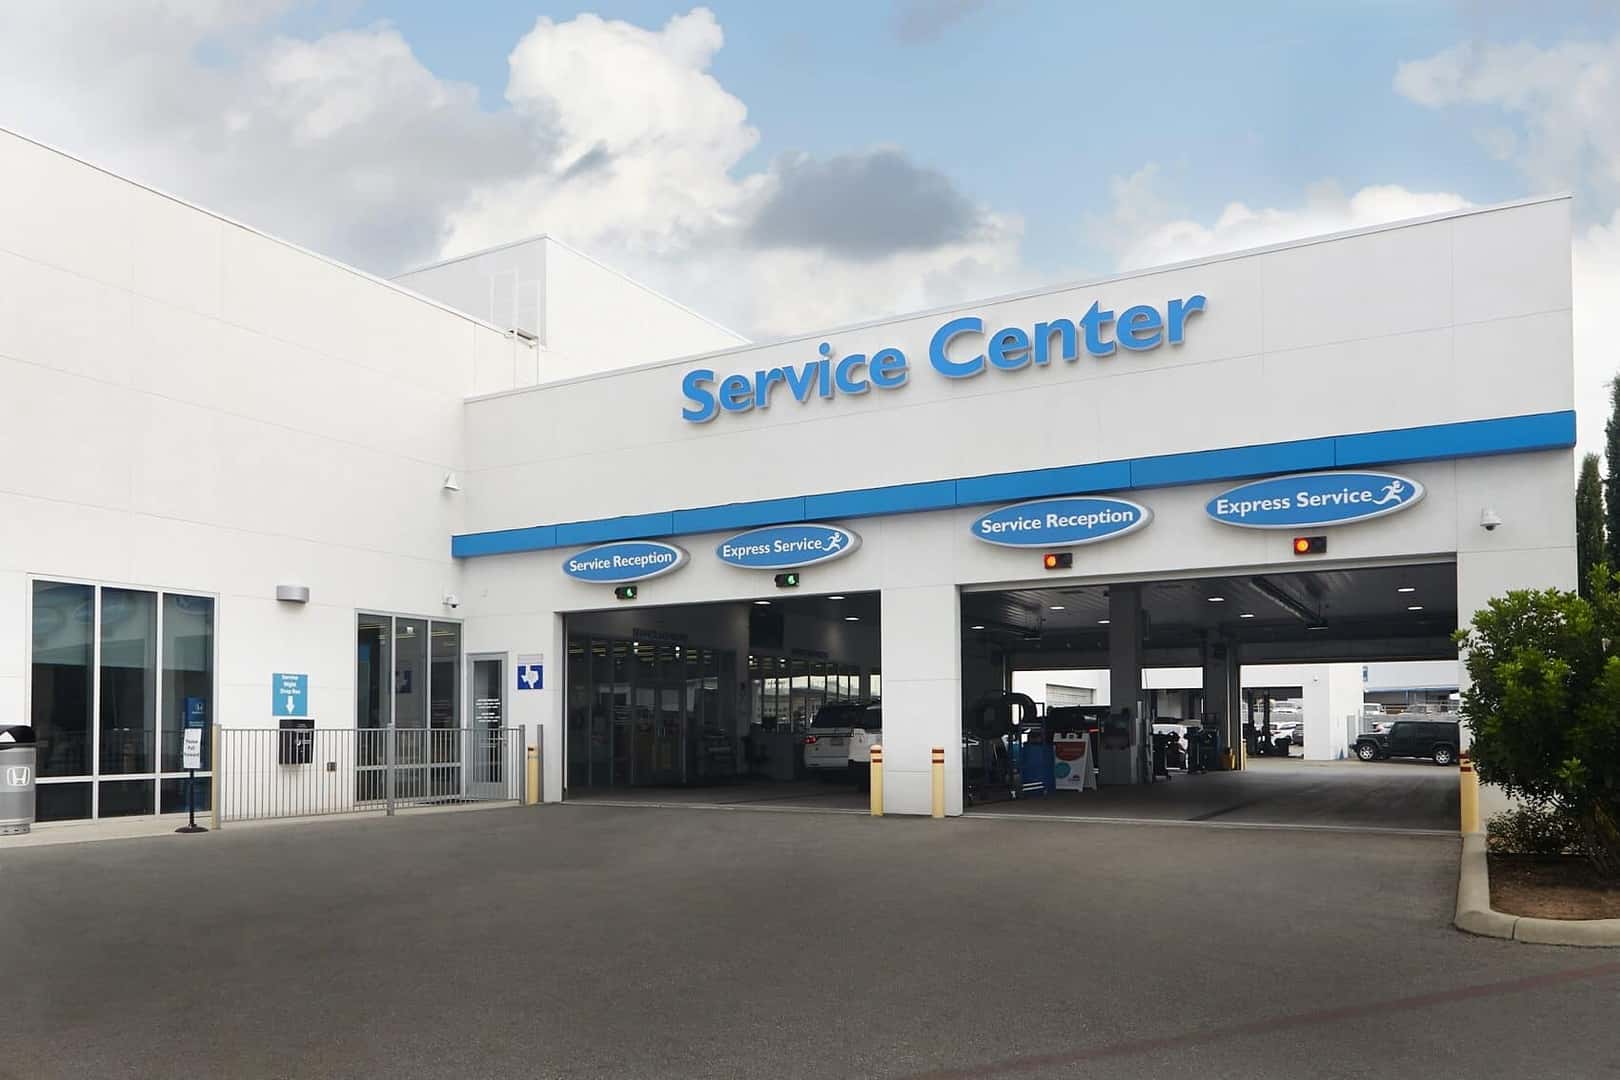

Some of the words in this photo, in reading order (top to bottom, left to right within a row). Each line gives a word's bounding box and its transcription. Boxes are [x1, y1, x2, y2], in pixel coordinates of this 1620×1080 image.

[682, 342, 908, 425] Service
[929, 292, 1209, 378] Center
[1216, 494, 1291, 515] Express
[1296, 488, 1373, 508] Service
[981, 517, 1042, 534] Service
[1046, 508, 1134, 529] Reception
[723, 543, 770, 559] Express
[774, 537, 822, 553] Service
[569, 557, 610, 572] Service
[613, 552, 672, 569] Reception
